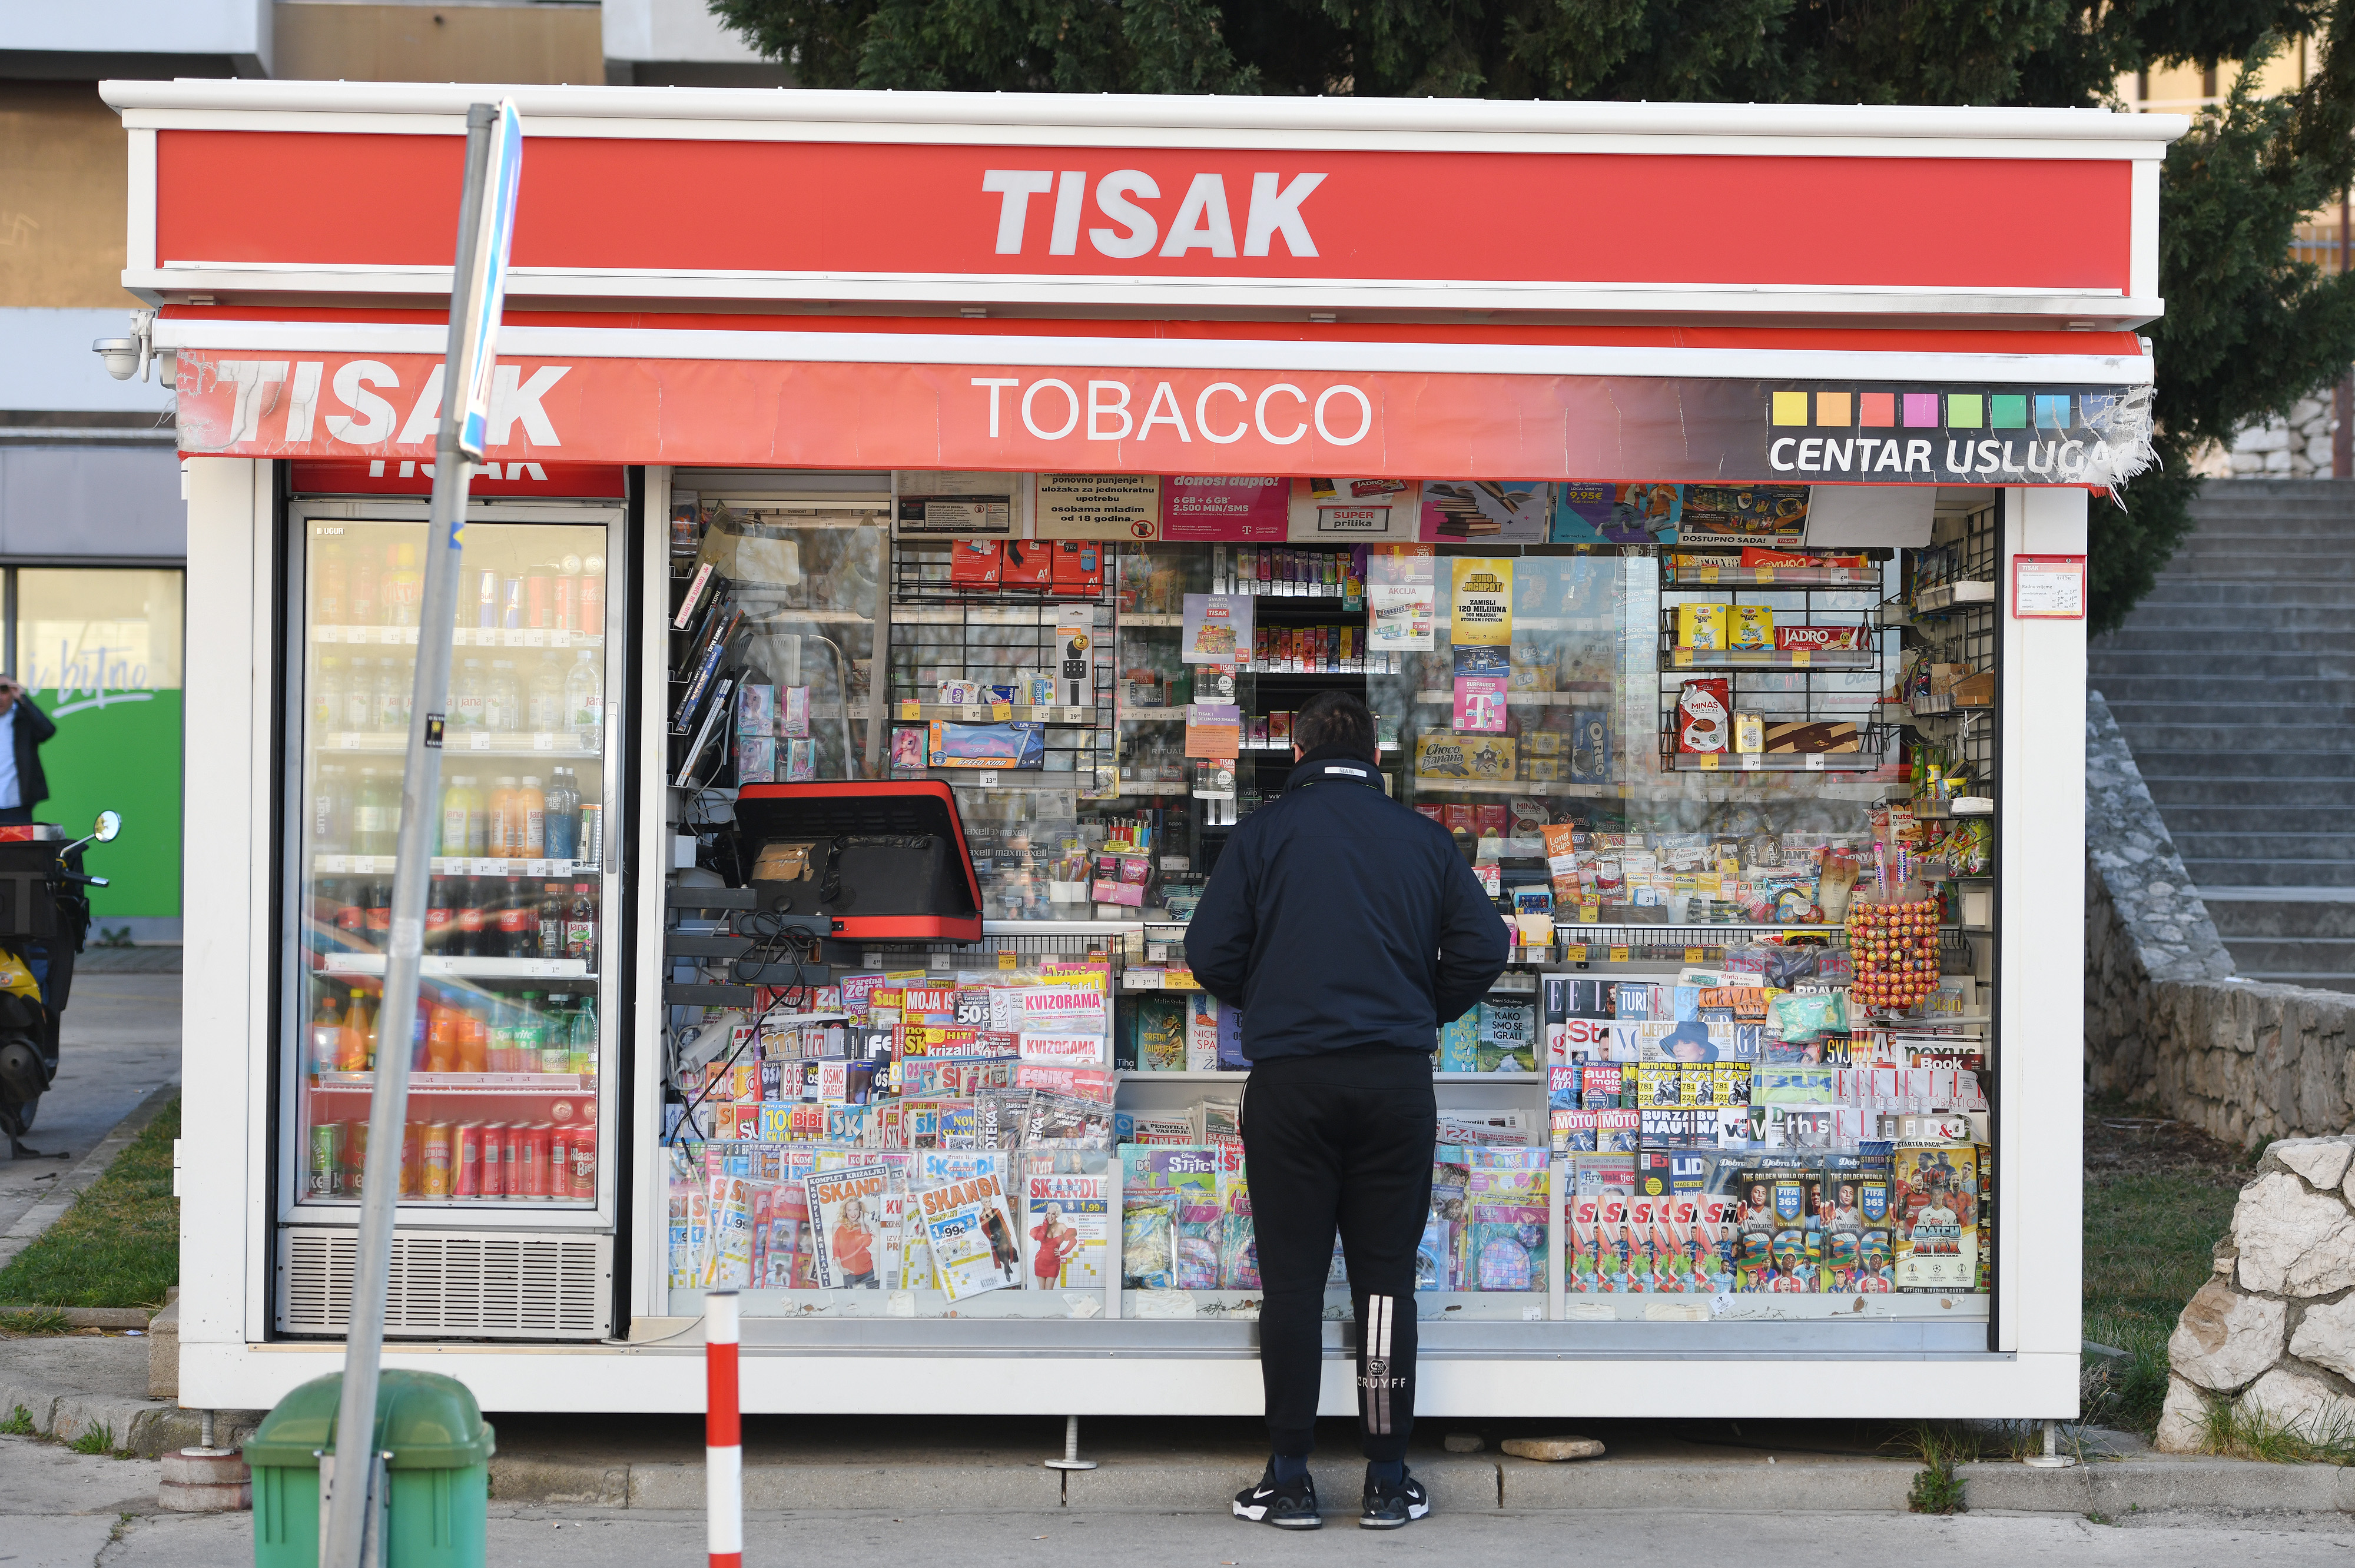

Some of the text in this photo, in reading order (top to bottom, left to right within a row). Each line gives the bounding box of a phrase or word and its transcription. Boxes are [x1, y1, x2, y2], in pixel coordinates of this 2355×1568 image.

[983, 168, 1328, 260] TISAK
[217, 359, 572, 447] TISAK
[971, 377, 1372, 446] TOBACCO
[1770, 438, 2114, 473] CENTAR USLUGA
[1357, 480, 1384, 488] JADRO
[1570, 491, 1603, 500] 9,95€
[1334, 520, 1372, 528] prilika
[984, 570, 995, 580] A1
[1037, 569, 1047, 579] A1
[1471, 574, 1493, 583] EURO
[1087, 576, 1097, 587] A1
[1462, 583, 1502, 592] JACKPOT
[1383, 605, 1405, 616] SNICKERS
[1783, 629, 1829, 645] JADRO
[1691, 701, 1718, 709] MINAS
[1427, 744, 1461, 755] Choco
[1590, 722, 1604, 776] OREO
[1421, 754, 1464, 768] Banana
[1550, 832, 1568, 846] Long
[1551, 840, 1570, 853] Chips
[1726, 956, 1763, 972] miss
[907, 991, 944, 1010] MOJA
[1026, 992, 1100, 1011] KVIZORAMA
[958, 1005, 983, 1024] 50
[1495, 1012, 1520, 1021] KAKO
[1492, 1022, 1512, 1030] SMO
[947, 1031, 971, 1041] HIT!
[1144, 1033, 1166, 1042] SRETNI
[1494, 1031, 1521, 1040] IGRALI
[1026, 1038, 1096, 1055] KVIZORAMA
[1144, 1044, 1173, 1054] ZAUVIJEK
[1921, 1057, 1963, 1069] Book
[824, 1067, 843, 1083] OSMO
[1020, 1069, 1074, 1089] FENIKS
[824, 1084, 843, 1096] SMJERKE
[1905, 1097, 1987, 1108] DECORATION
[1447, 1128, 1473, 1142] 24
[1466, 1149, 1546, 1168] ZAGONETKE
[925, 1155, 995, 1178] SKANDI
[810, 1168, 884, 1185] KOMPLET KRIŽALJKI
[1831, 1173, 1883, 1182] THE GOLDEN WORLD
[818, 1176, 888, 1204] SKANDI
[1030, 1178, 1099, 1198] SKANDI
[923, 1175, 1001, 1215] SKANDI
[1080, 1201, 1104, 1212] 1,99€
[1779, 1198, 1797, 1206] 365
[1865, 1198, 1883, 1207] 365
[927, 1207, 980, 1225] KOMPLET HRVATSKA
[931, 1222, 966, 1239] 1,99€
[1914, 1225, 1961, 1238] MATCH
[1913, 1241, 1961, 1254] ATTAX
[1358, 1377, 1407, 1388] CRUYFF
